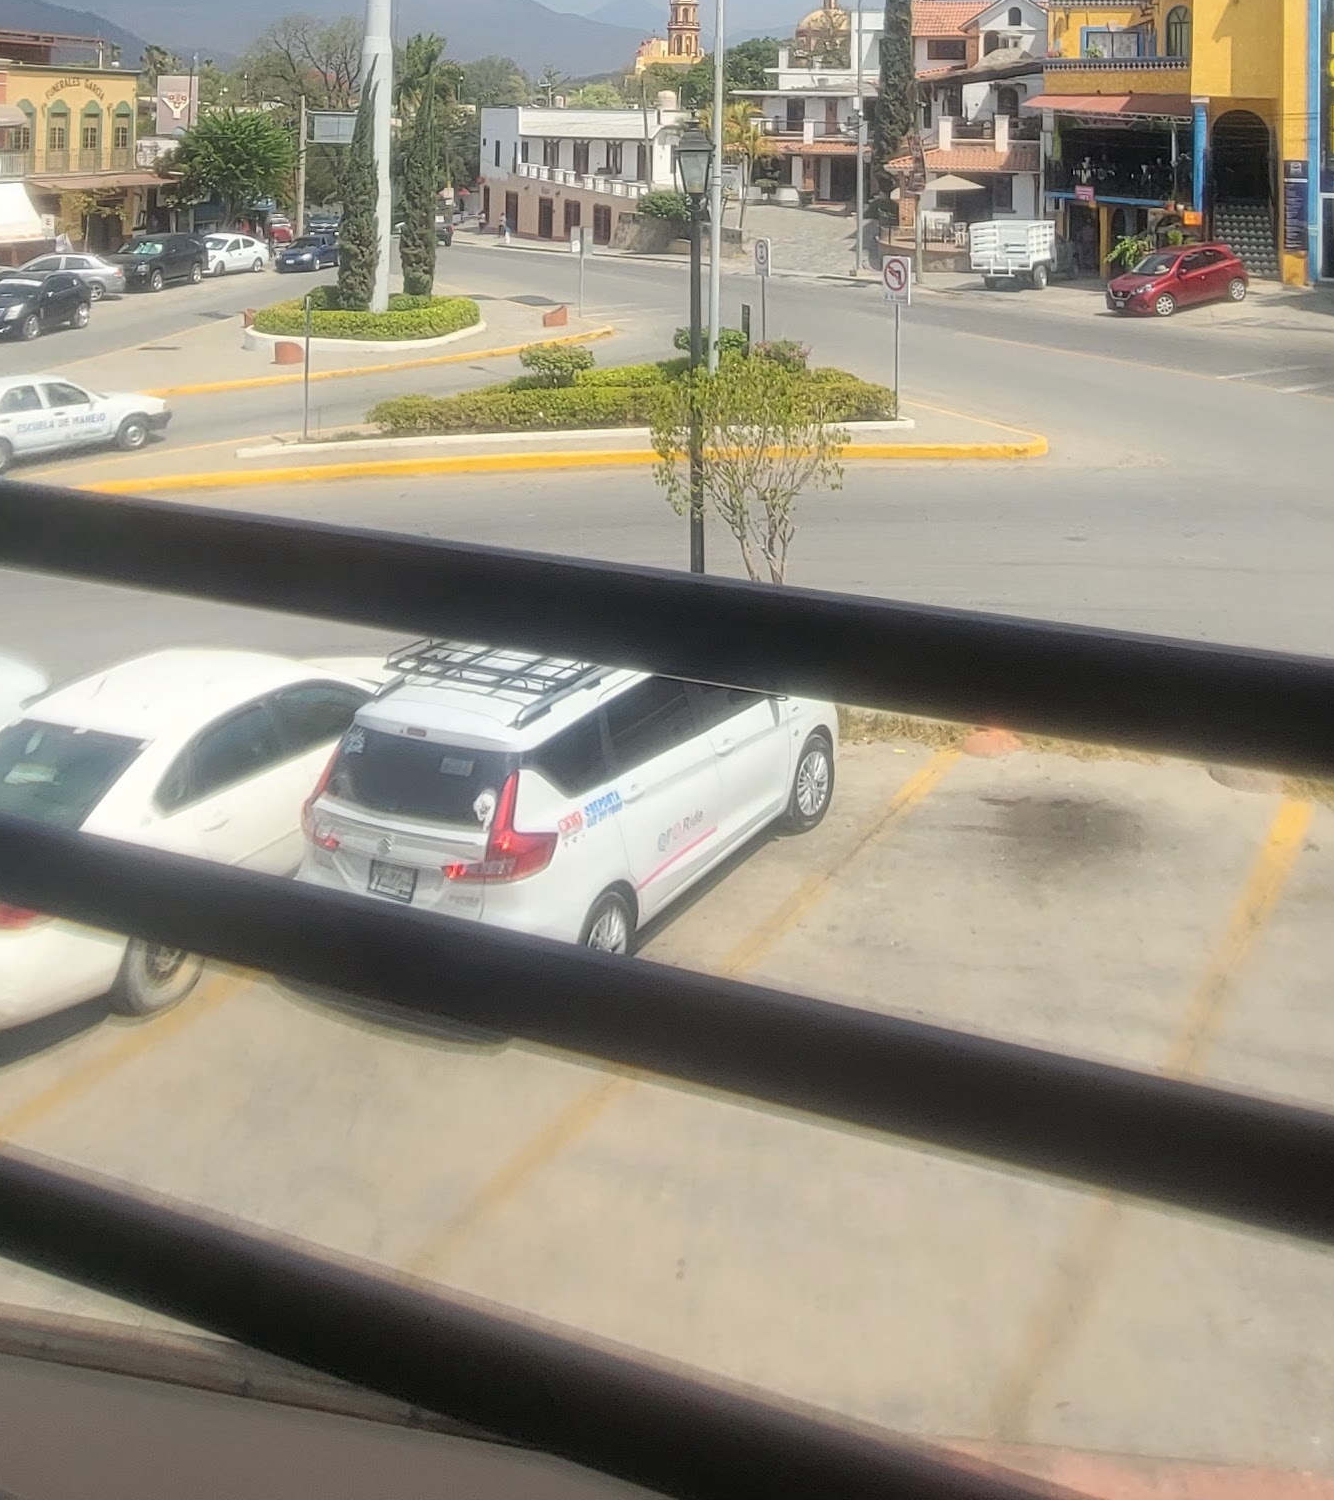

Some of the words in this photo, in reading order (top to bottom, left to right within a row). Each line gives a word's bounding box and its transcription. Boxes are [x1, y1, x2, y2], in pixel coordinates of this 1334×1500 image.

[45, 77, 80, 100] FUNERALES
[17, 420, 55, 434] ESCUELA
[58, 418, 70, 428] DE
[72, 412, 106, 425] MANEJO
[683, 809, 704, 833] Ride
